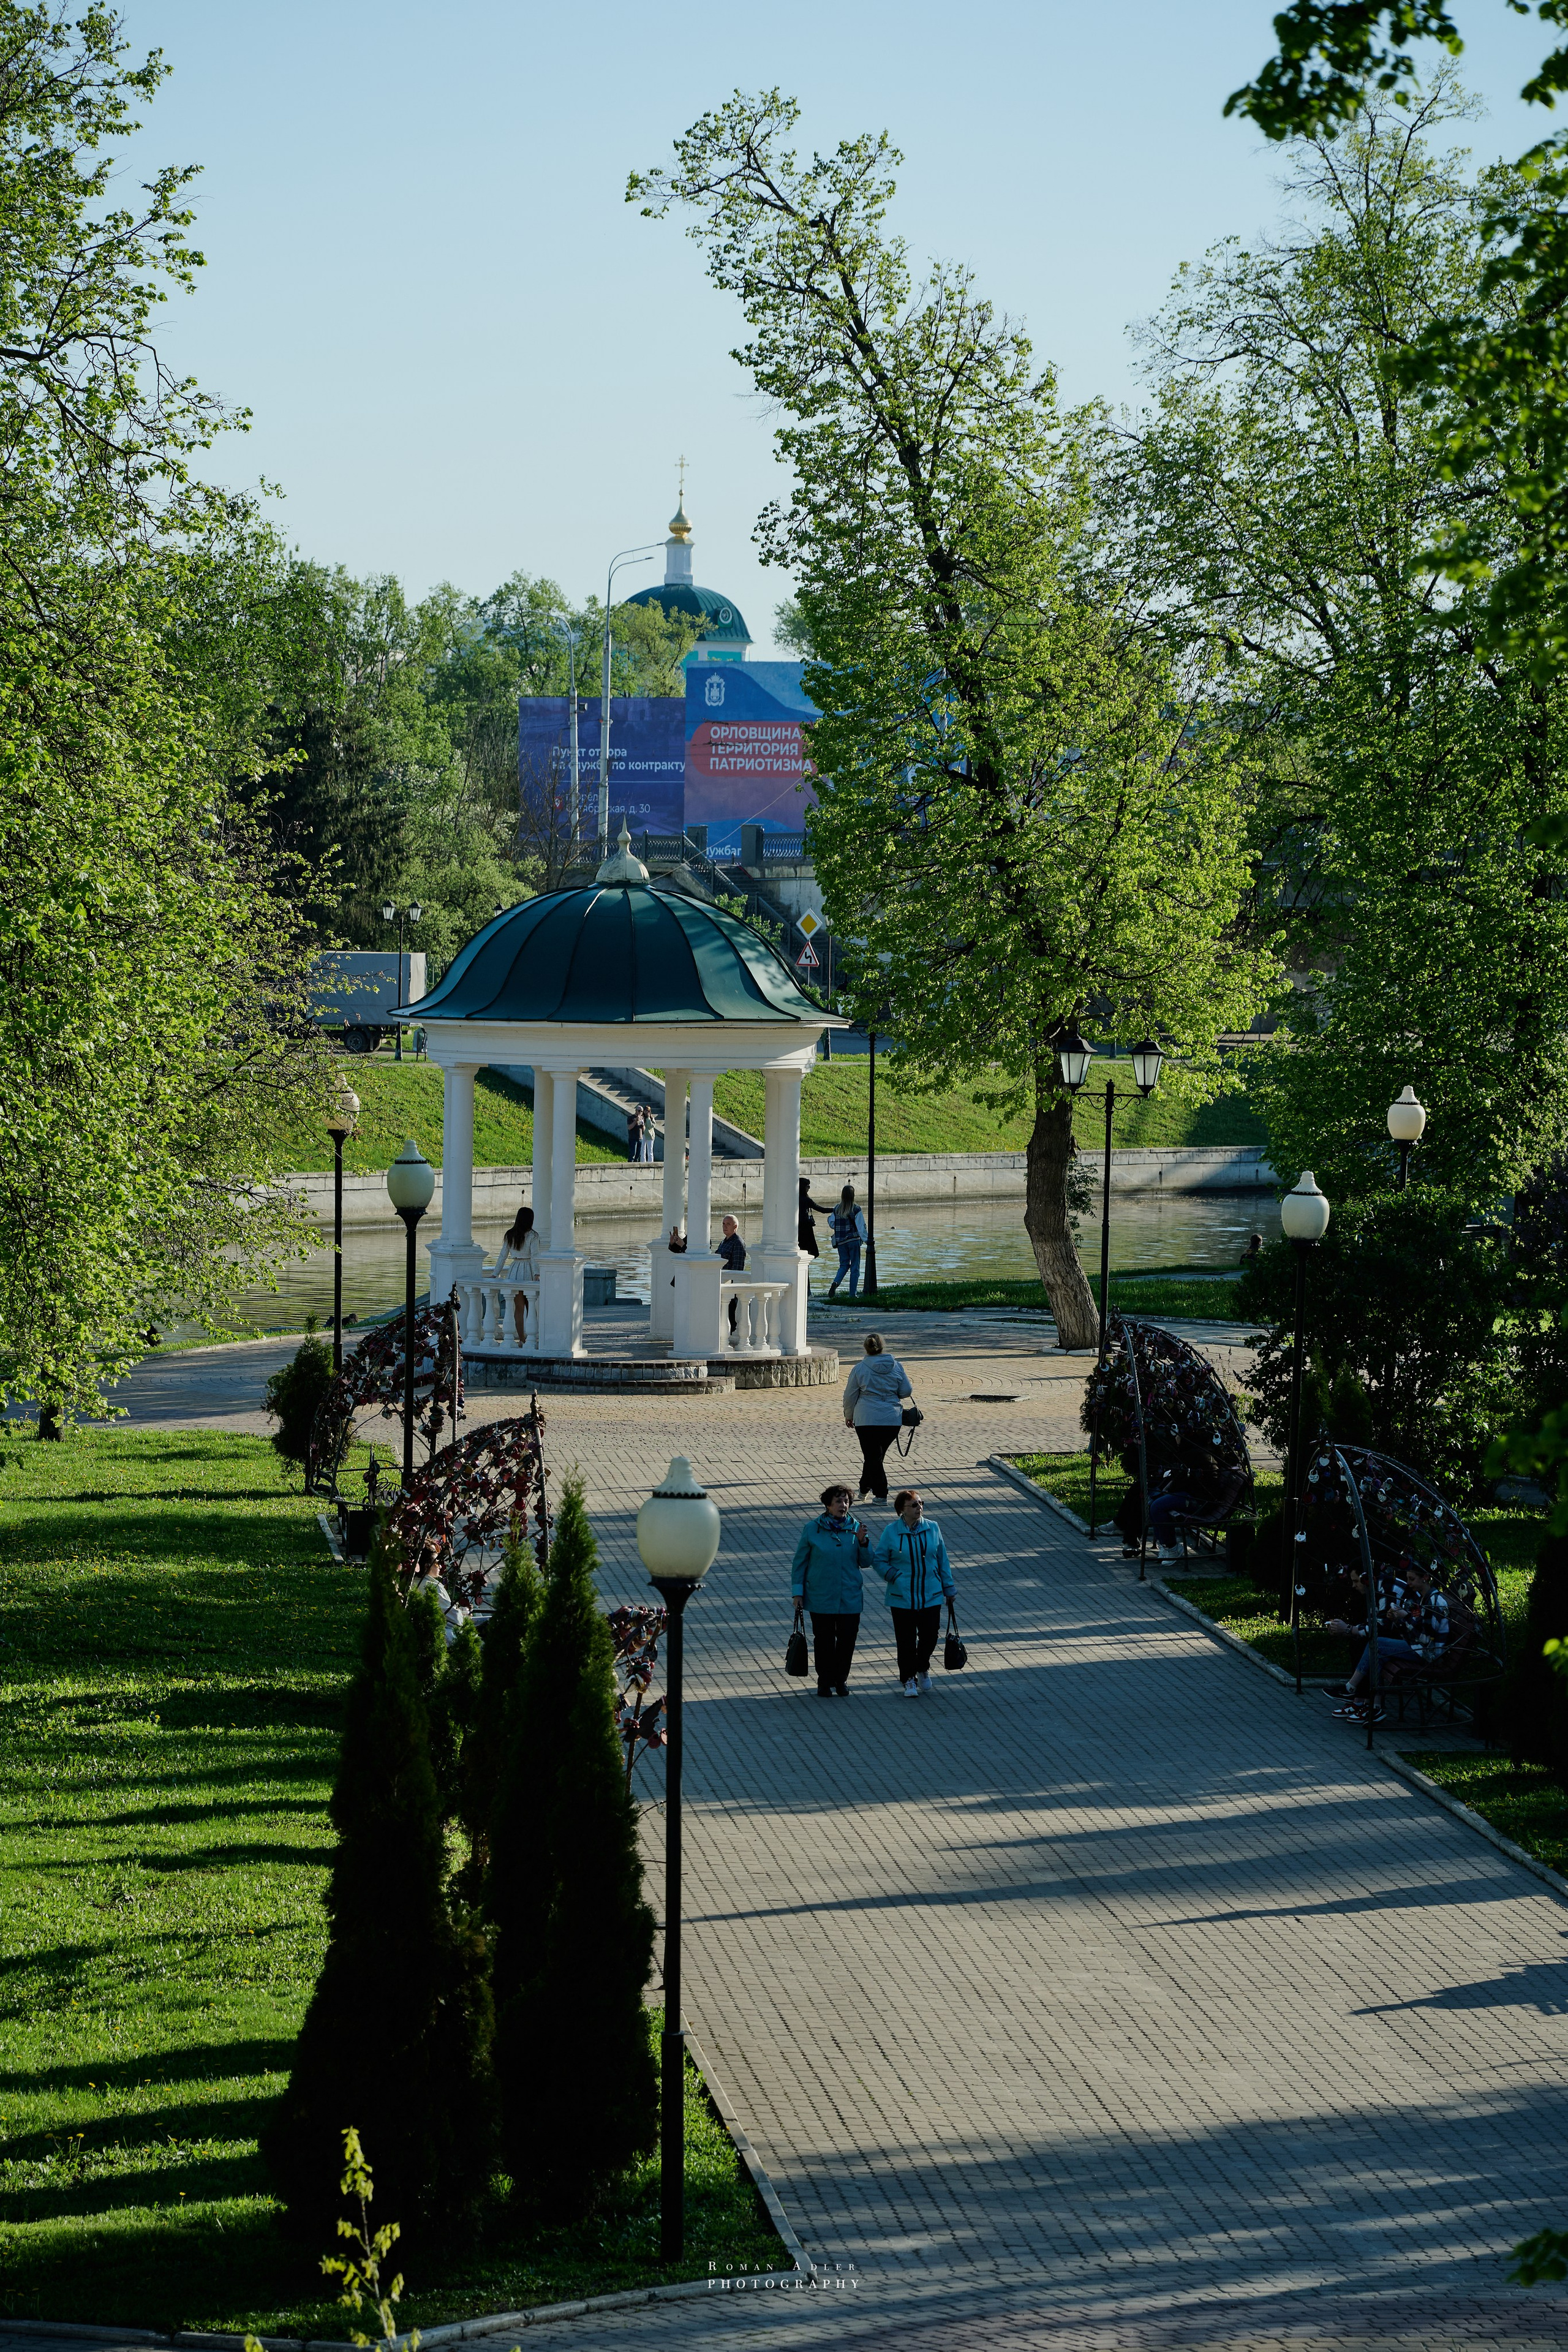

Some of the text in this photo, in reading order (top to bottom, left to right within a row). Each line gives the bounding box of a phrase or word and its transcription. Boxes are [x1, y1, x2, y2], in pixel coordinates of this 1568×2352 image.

[710, 726, 801, 741] ОРЛОВЩИНА
[552, 746, 627, 759] Пут отора
[711, 742, 798, 755] ТЕРРИТОРИЯ
[612, 761, 625, 770] по
[628, 761, 685, 772] контракту
[710, 757, 813, 772] ПАТРИОТИЗМА
[578, 793, 598, 803] рёл
[639, 804, 650, 813] 30
